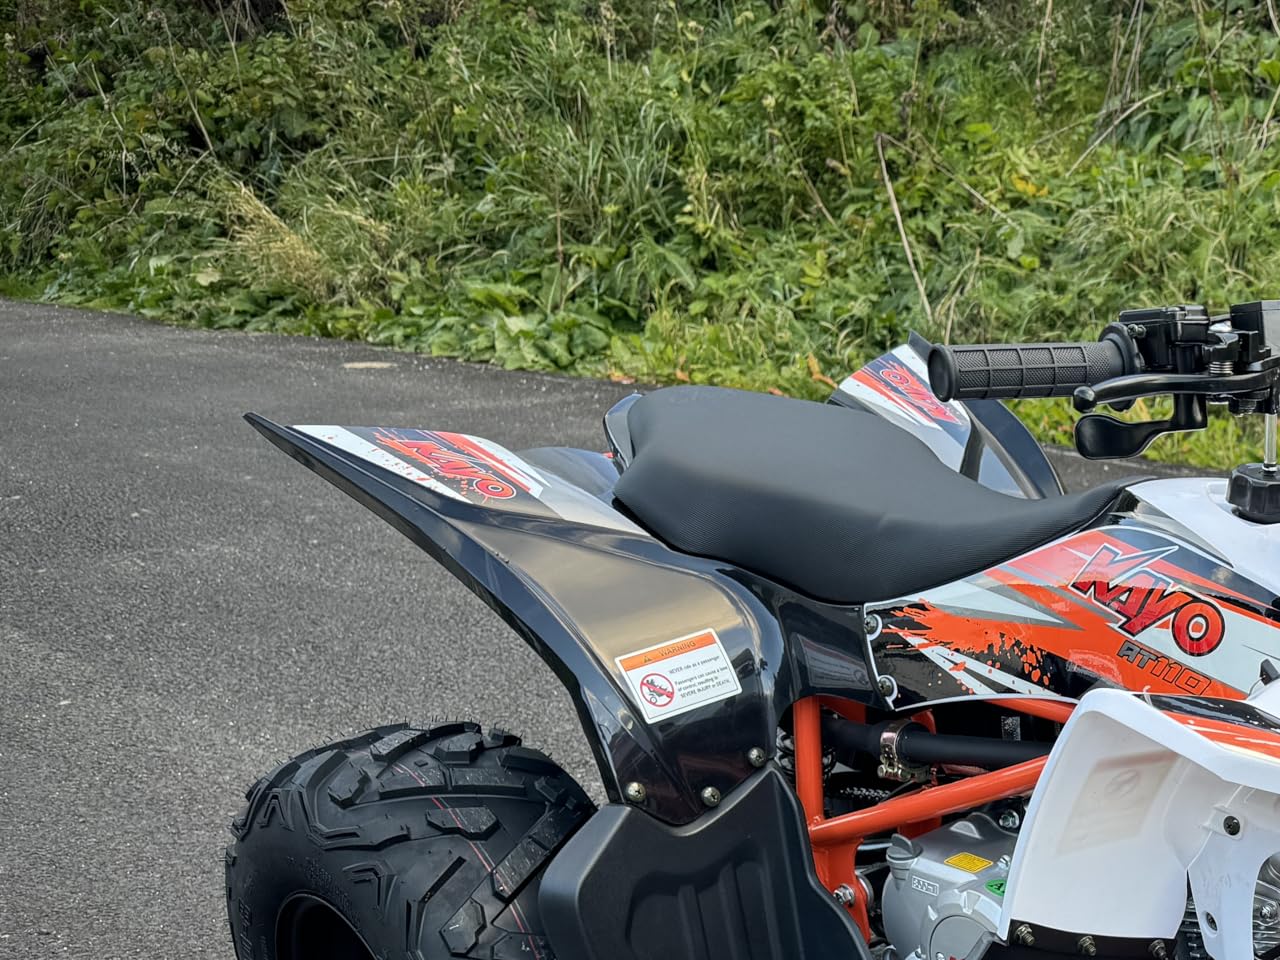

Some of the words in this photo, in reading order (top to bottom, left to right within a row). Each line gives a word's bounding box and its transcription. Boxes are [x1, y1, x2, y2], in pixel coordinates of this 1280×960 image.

[397, 440, 517, 500] KAYO
[1068, 543, 1226, 657] KAYO
[659, 641, 696, 657] WARNING
[1116, 640, 1212, 695] AT110
